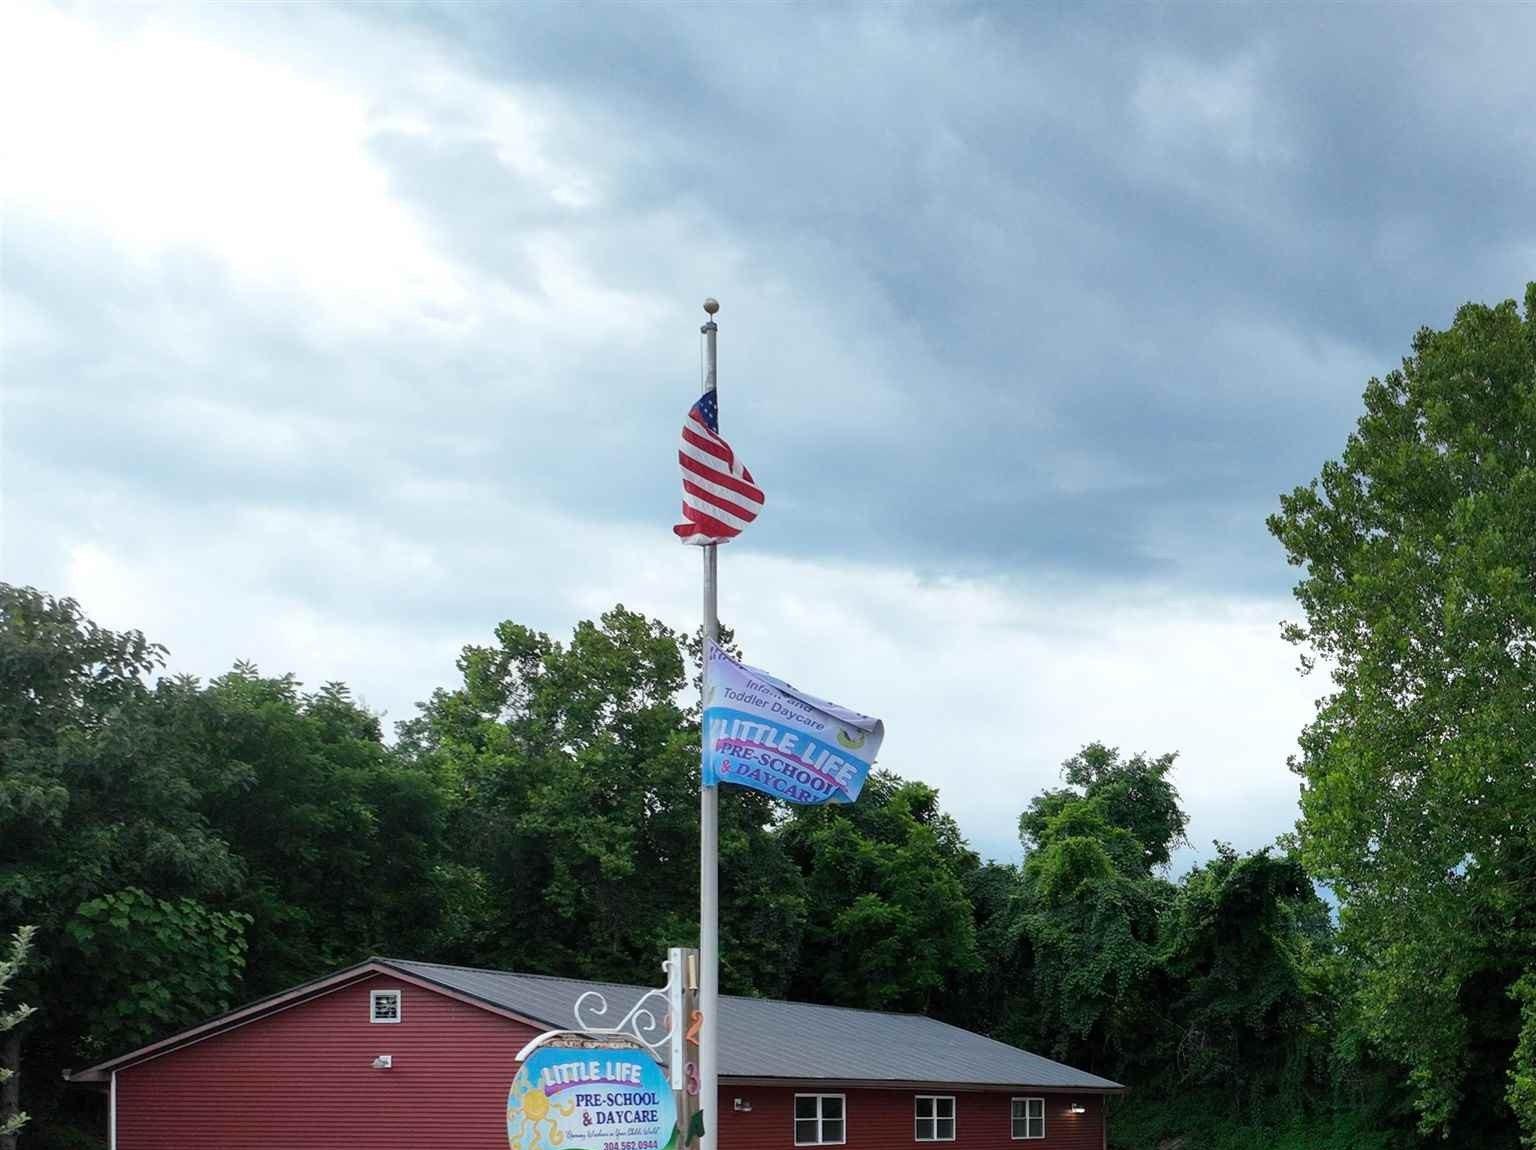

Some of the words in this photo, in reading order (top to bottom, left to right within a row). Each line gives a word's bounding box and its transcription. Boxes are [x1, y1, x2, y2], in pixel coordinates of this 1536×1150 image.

[724, 687, 769, 708] Toddler
[771, 702, 825, 731] Daycare
[720, 719, 799, 754] LITTLE
[802, 742, 858, 786] LIFE
[736, 763, 820, 801] DAYCAR
[541, 1061, 600, 1087] LITTLE
[605, 1062, 643, 1083] LIFE
[575, 1092, 660, 1107] PRE-SCHOOL
[582, 1111, 593, 1126] &
[596, 1110, 659, 1125] DAYCARE
